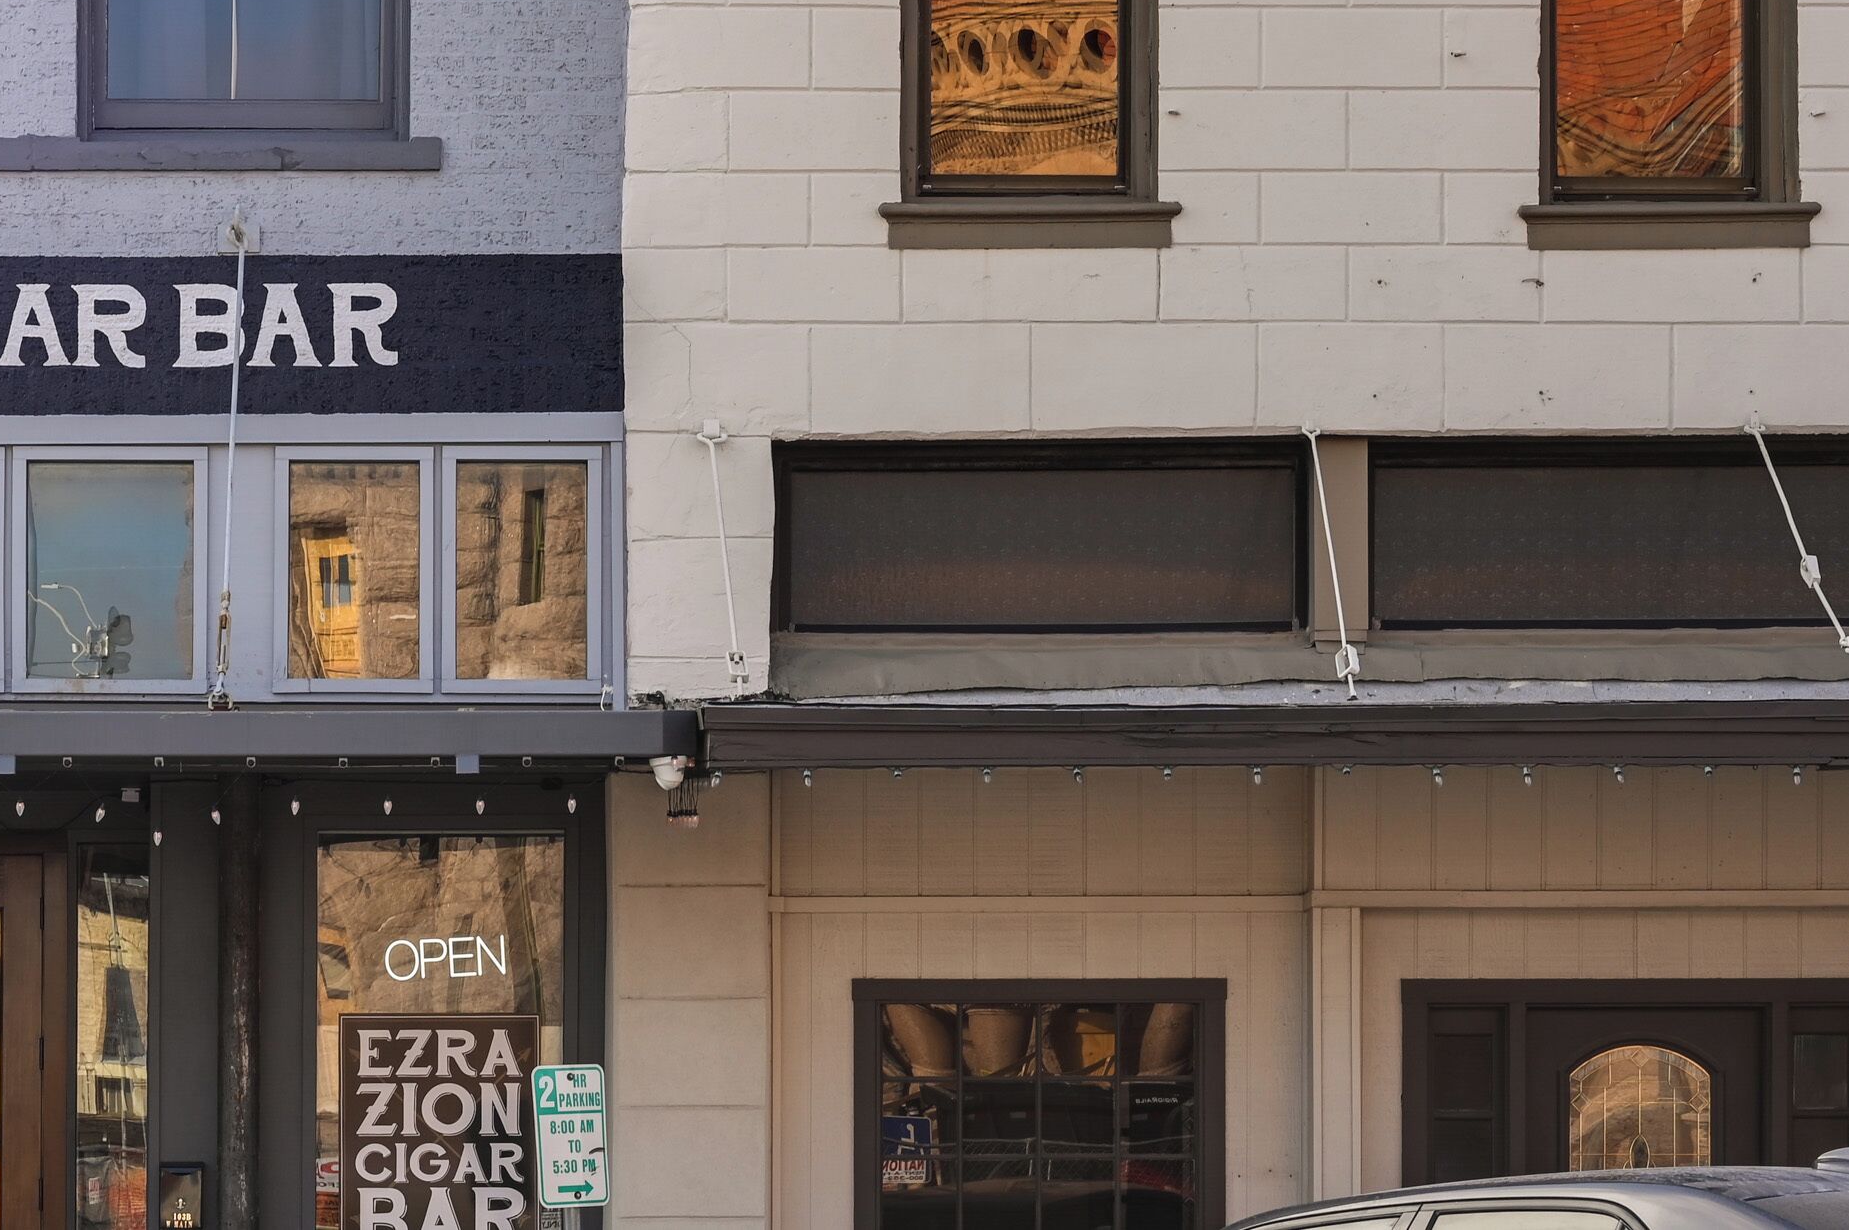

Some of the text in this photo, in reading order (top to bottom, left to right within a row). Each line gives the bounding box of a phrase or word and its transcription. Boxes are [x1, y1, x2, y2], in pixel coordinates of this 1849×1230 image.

[172, 282, 399, 368] BAR
[384, 934, 506, 981] OPEN
[356, 1029, 523, 1077] EZRA
[538, 1075, 555, 1109] 2
[572, 1073, 587, 1088] HR
[355, 1082, 522, 1137] ZION
[558, 1092, 601, 1108] PARKING
[550, 1119, 594, 1134] 8:00 AM
[354, 1142, 525, 1184] CIGAR
[568, 1139, 581, 1153] TO
[553, 1158, 597, 1174] 5:30 PM
[355, 1186, 527, 1230] BAR
